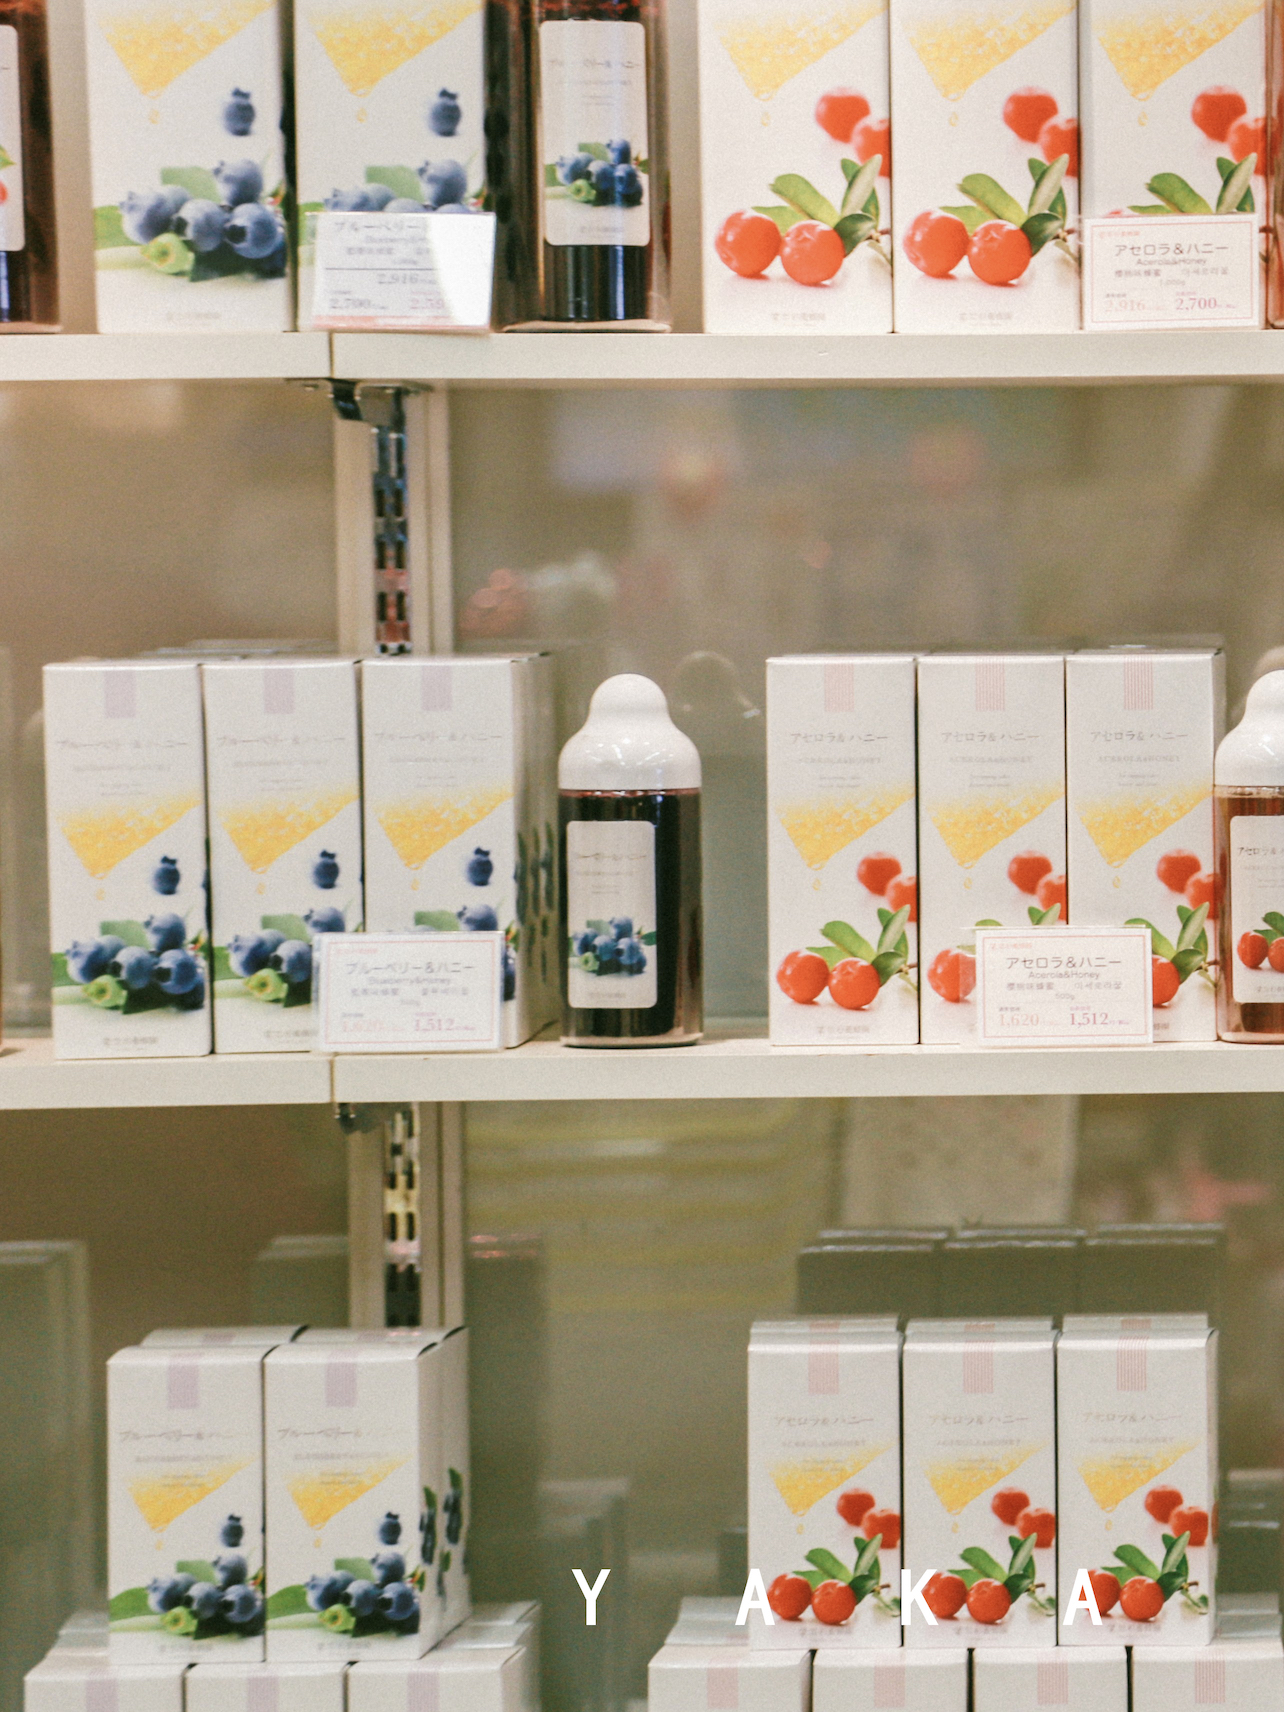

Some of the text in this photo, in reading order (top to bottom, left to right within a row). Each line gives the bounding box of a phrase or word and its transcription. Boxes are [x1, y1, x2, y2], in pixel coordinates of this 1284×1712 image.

[1114, 243, 1229, 257] アセロラ&ハニー
[1174, 297, 1218, 311] 2,700
[1006, 957, 1123, 970] アセロラ&ハニー
[414, 1018, 455, 1032] 1,512
[999, 1012, 1110, 1028] 1,620 1,512
